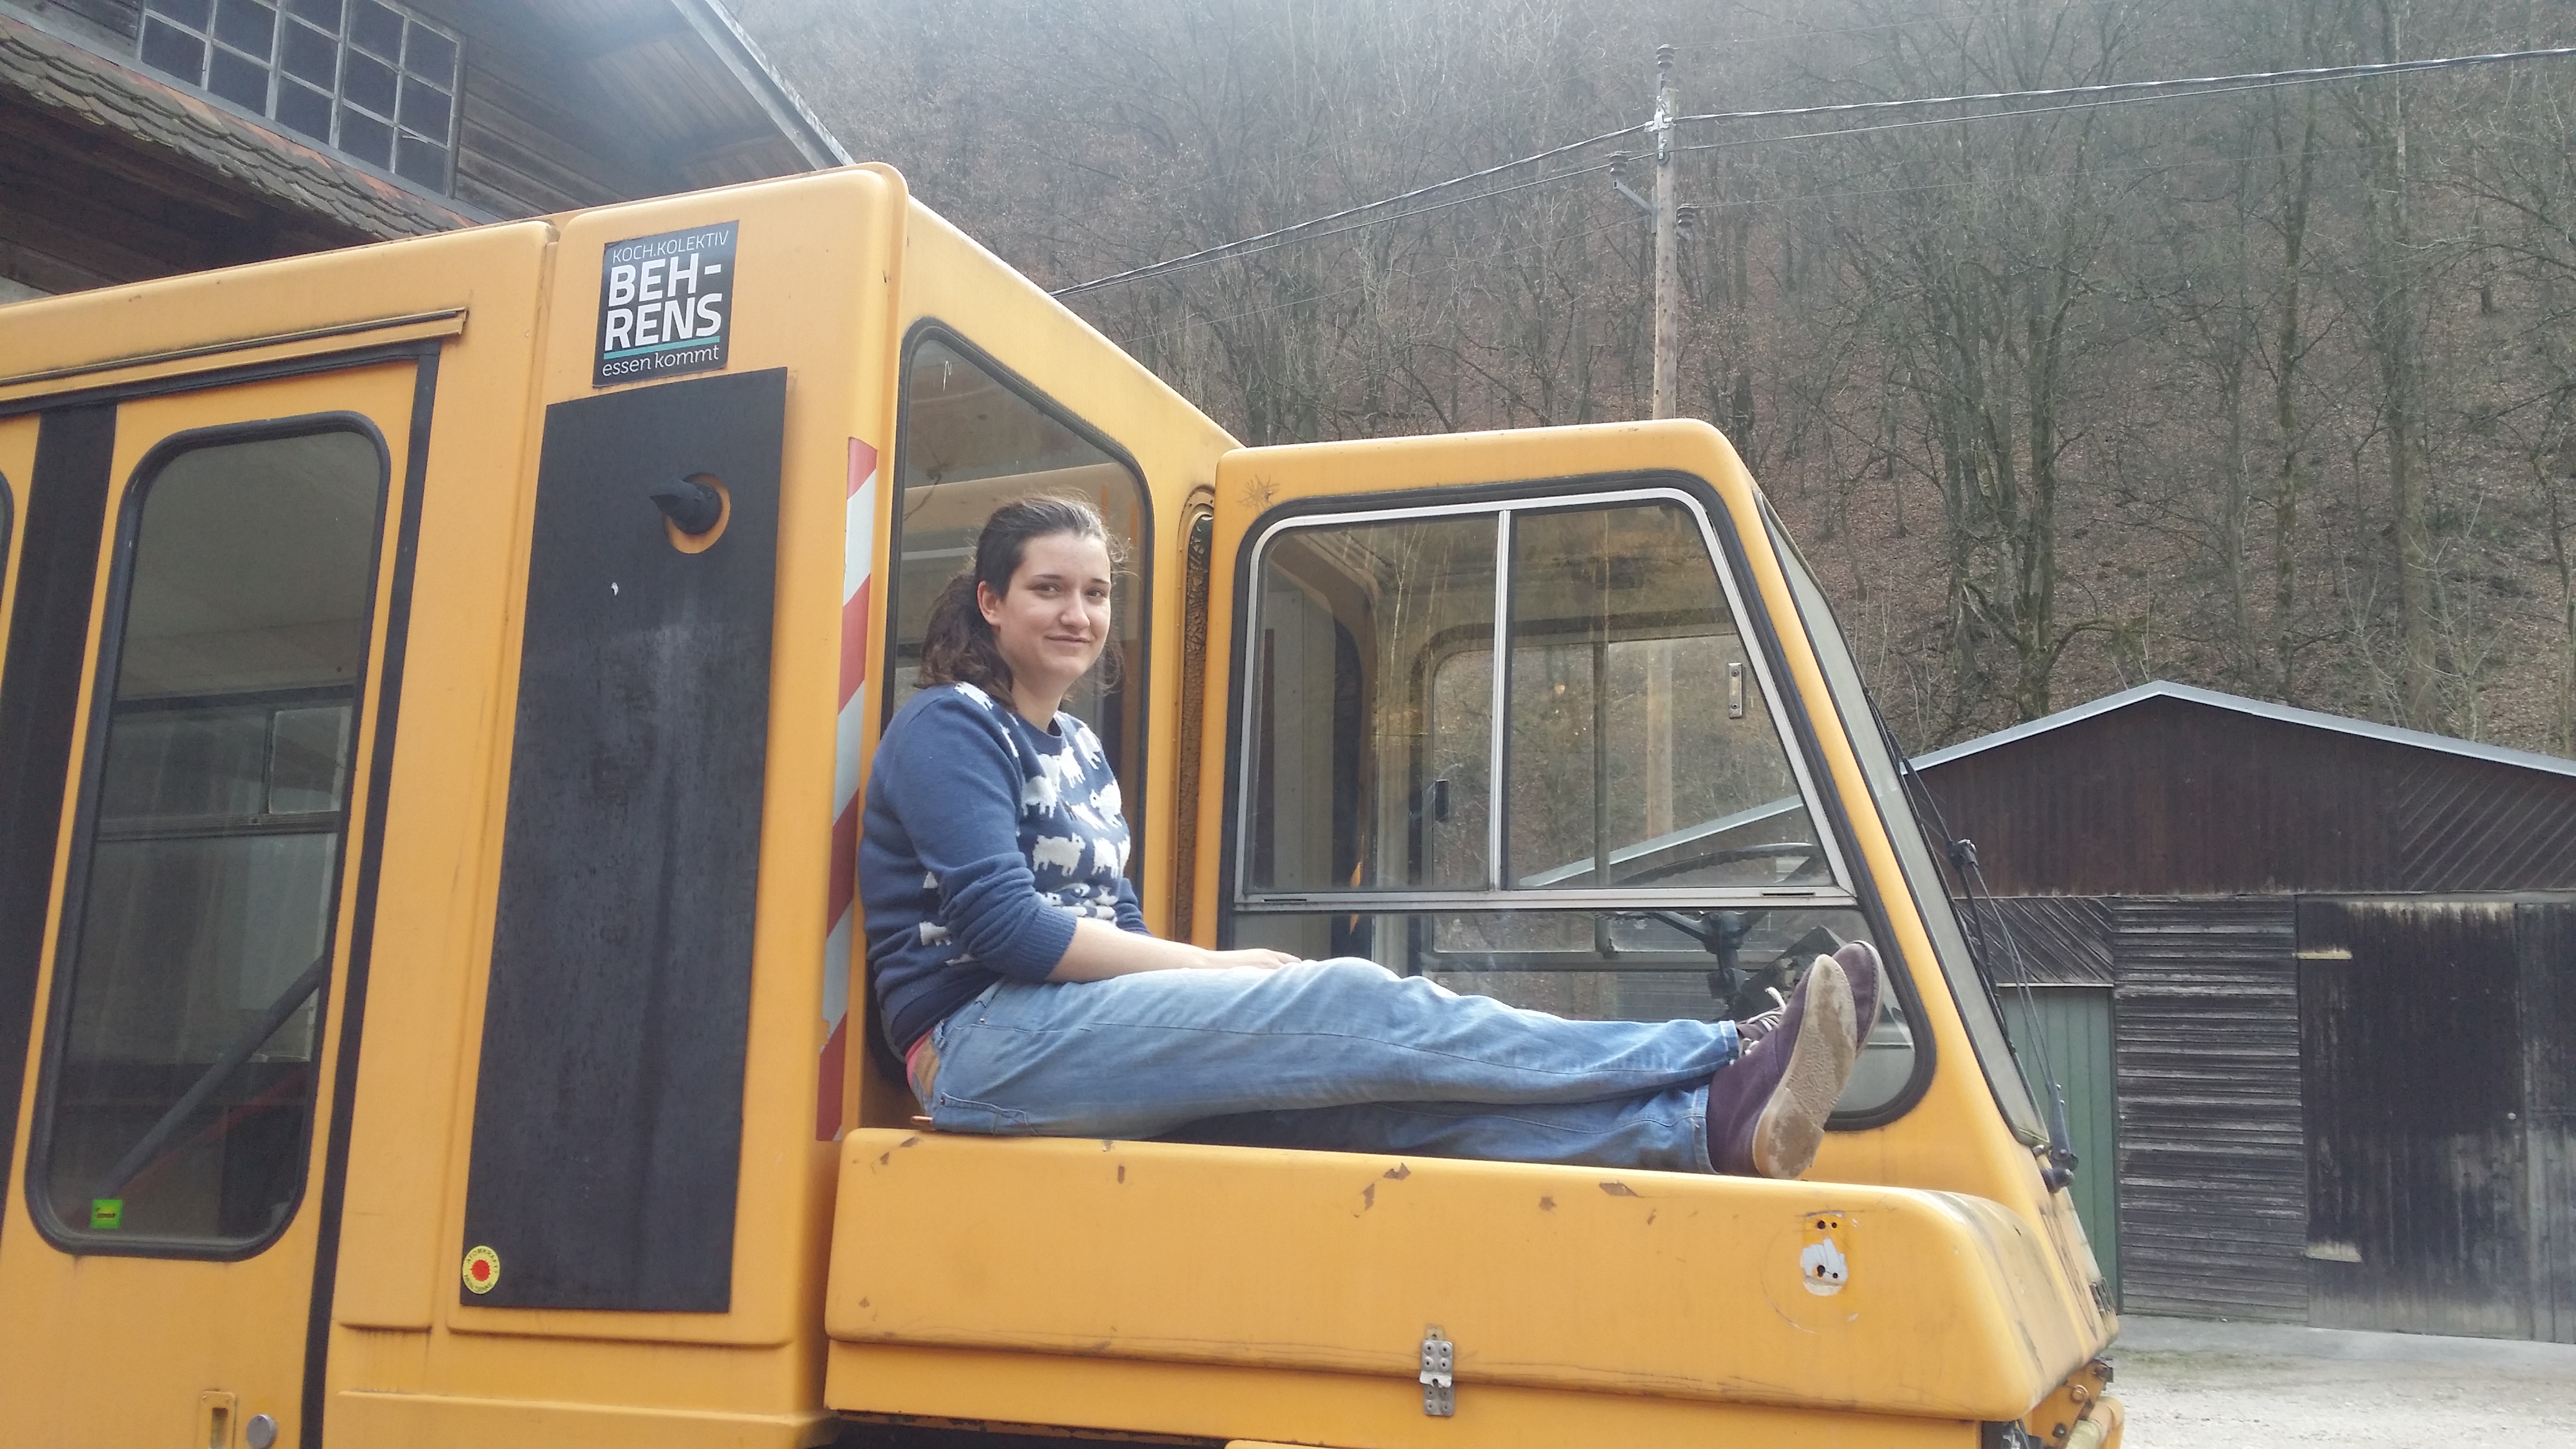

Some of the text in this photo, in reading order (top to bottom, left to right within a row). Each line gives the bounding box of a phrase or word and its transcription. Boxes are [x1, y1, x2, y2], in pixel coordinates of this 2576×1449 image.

[613, 231, 728, 263] KOCH.KOLEKTIV
[608, 253, 721, 307] BEH-
[605, 293, 722, 351] RENS
[602, 344, 719, 377] essen kommt
